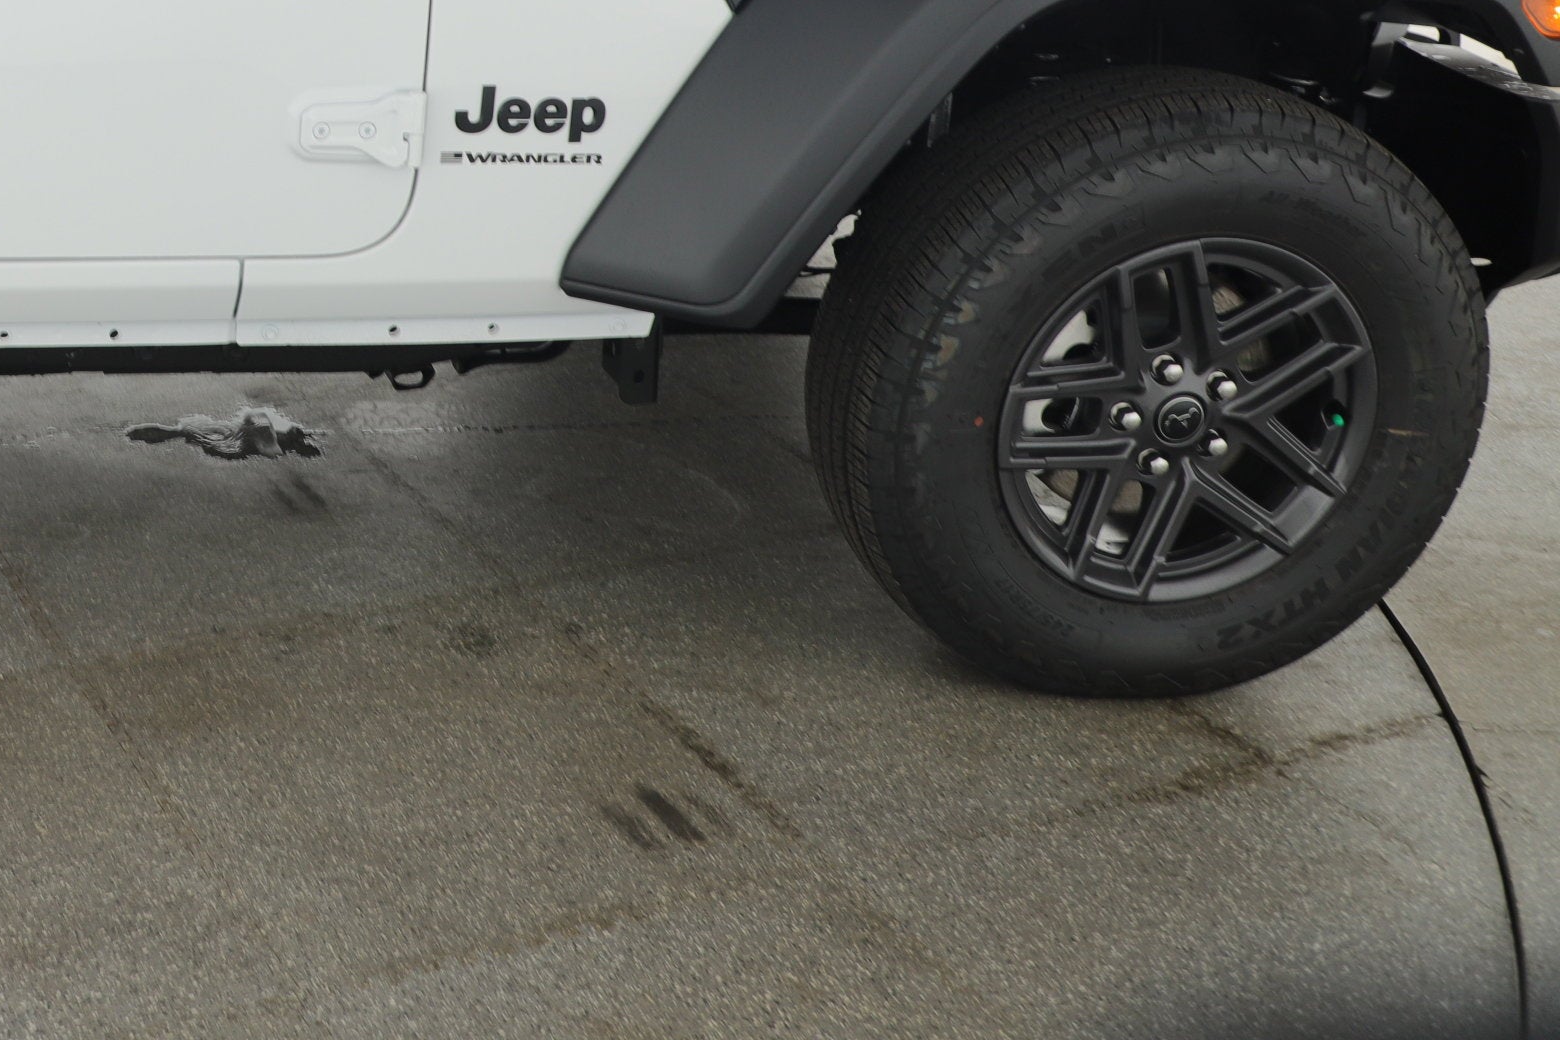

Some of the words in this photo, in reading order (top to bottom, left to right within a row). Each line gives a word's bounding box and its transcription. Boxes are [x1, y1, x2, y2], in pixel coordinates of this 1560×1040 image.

[454, 84, 606, 143] Jeep
[465, 151, 604, 165] WRANGLER
[1215, 575, 1331, 651] HTX2
